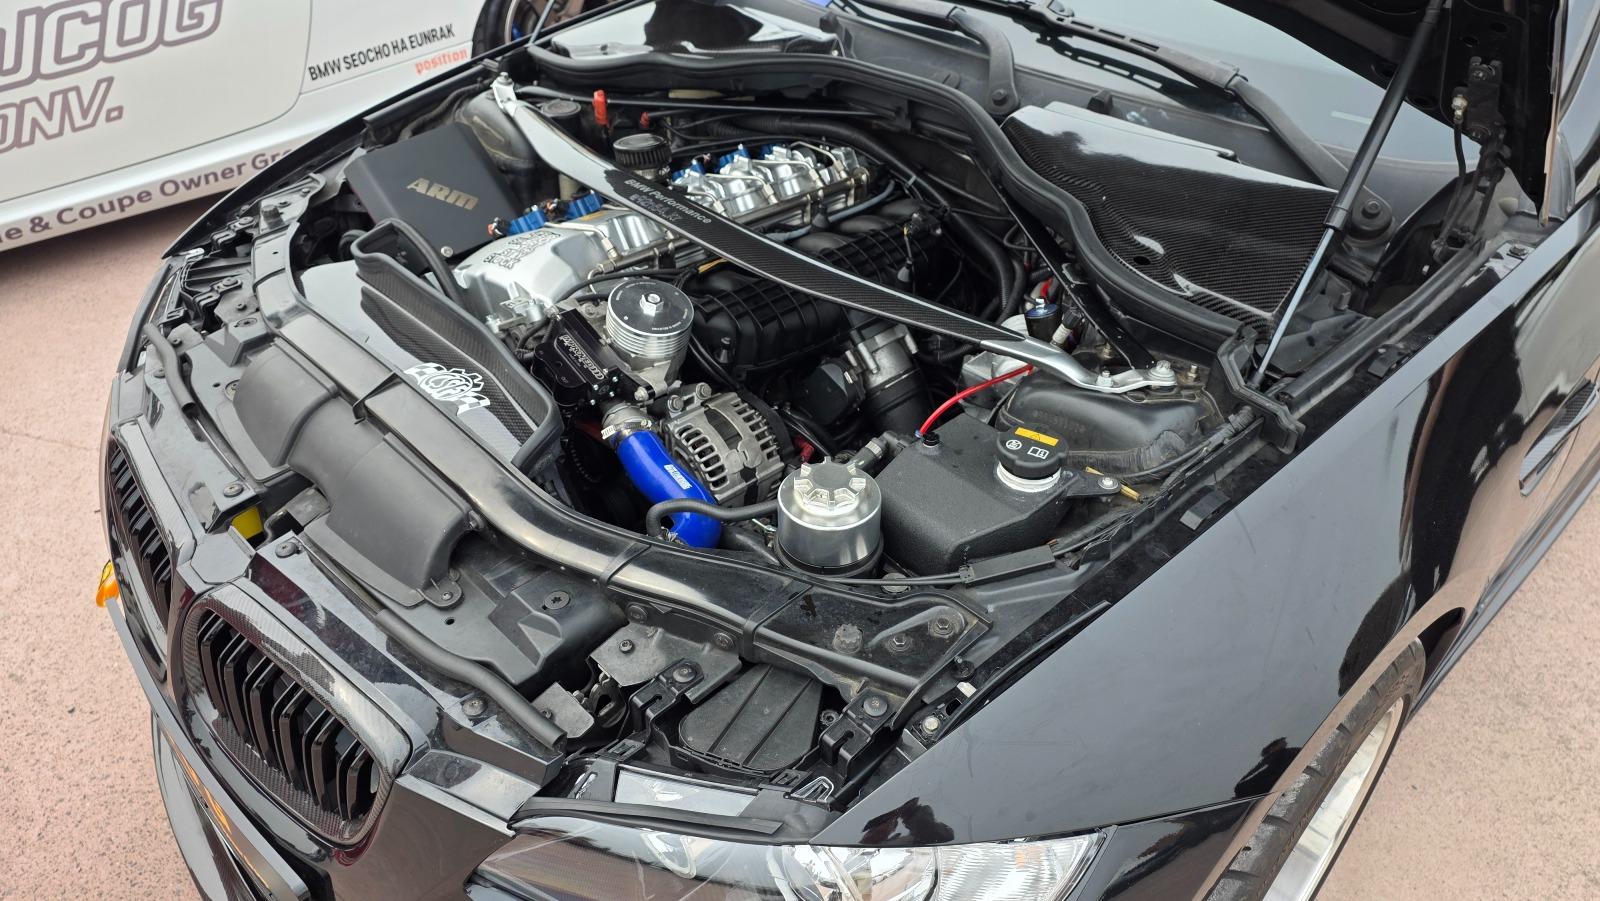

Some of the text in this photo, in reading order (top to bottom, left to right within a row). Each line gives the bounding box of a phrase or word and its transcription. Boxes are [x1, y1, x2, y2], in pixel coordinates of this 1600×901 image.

[308, 23, 455, 81] BMW SEOCHO HA EUNRAK
[415, 48, 468, 76] position
[30, 216, 52, 233] &
[56, 189, 153, 226] Coupe
[159, 162, 247, 197] Owner
[251, 149, 292, 170] Gr
[624, 179, 654, 193] BMW
[648, 190, 712, 224] Performance
